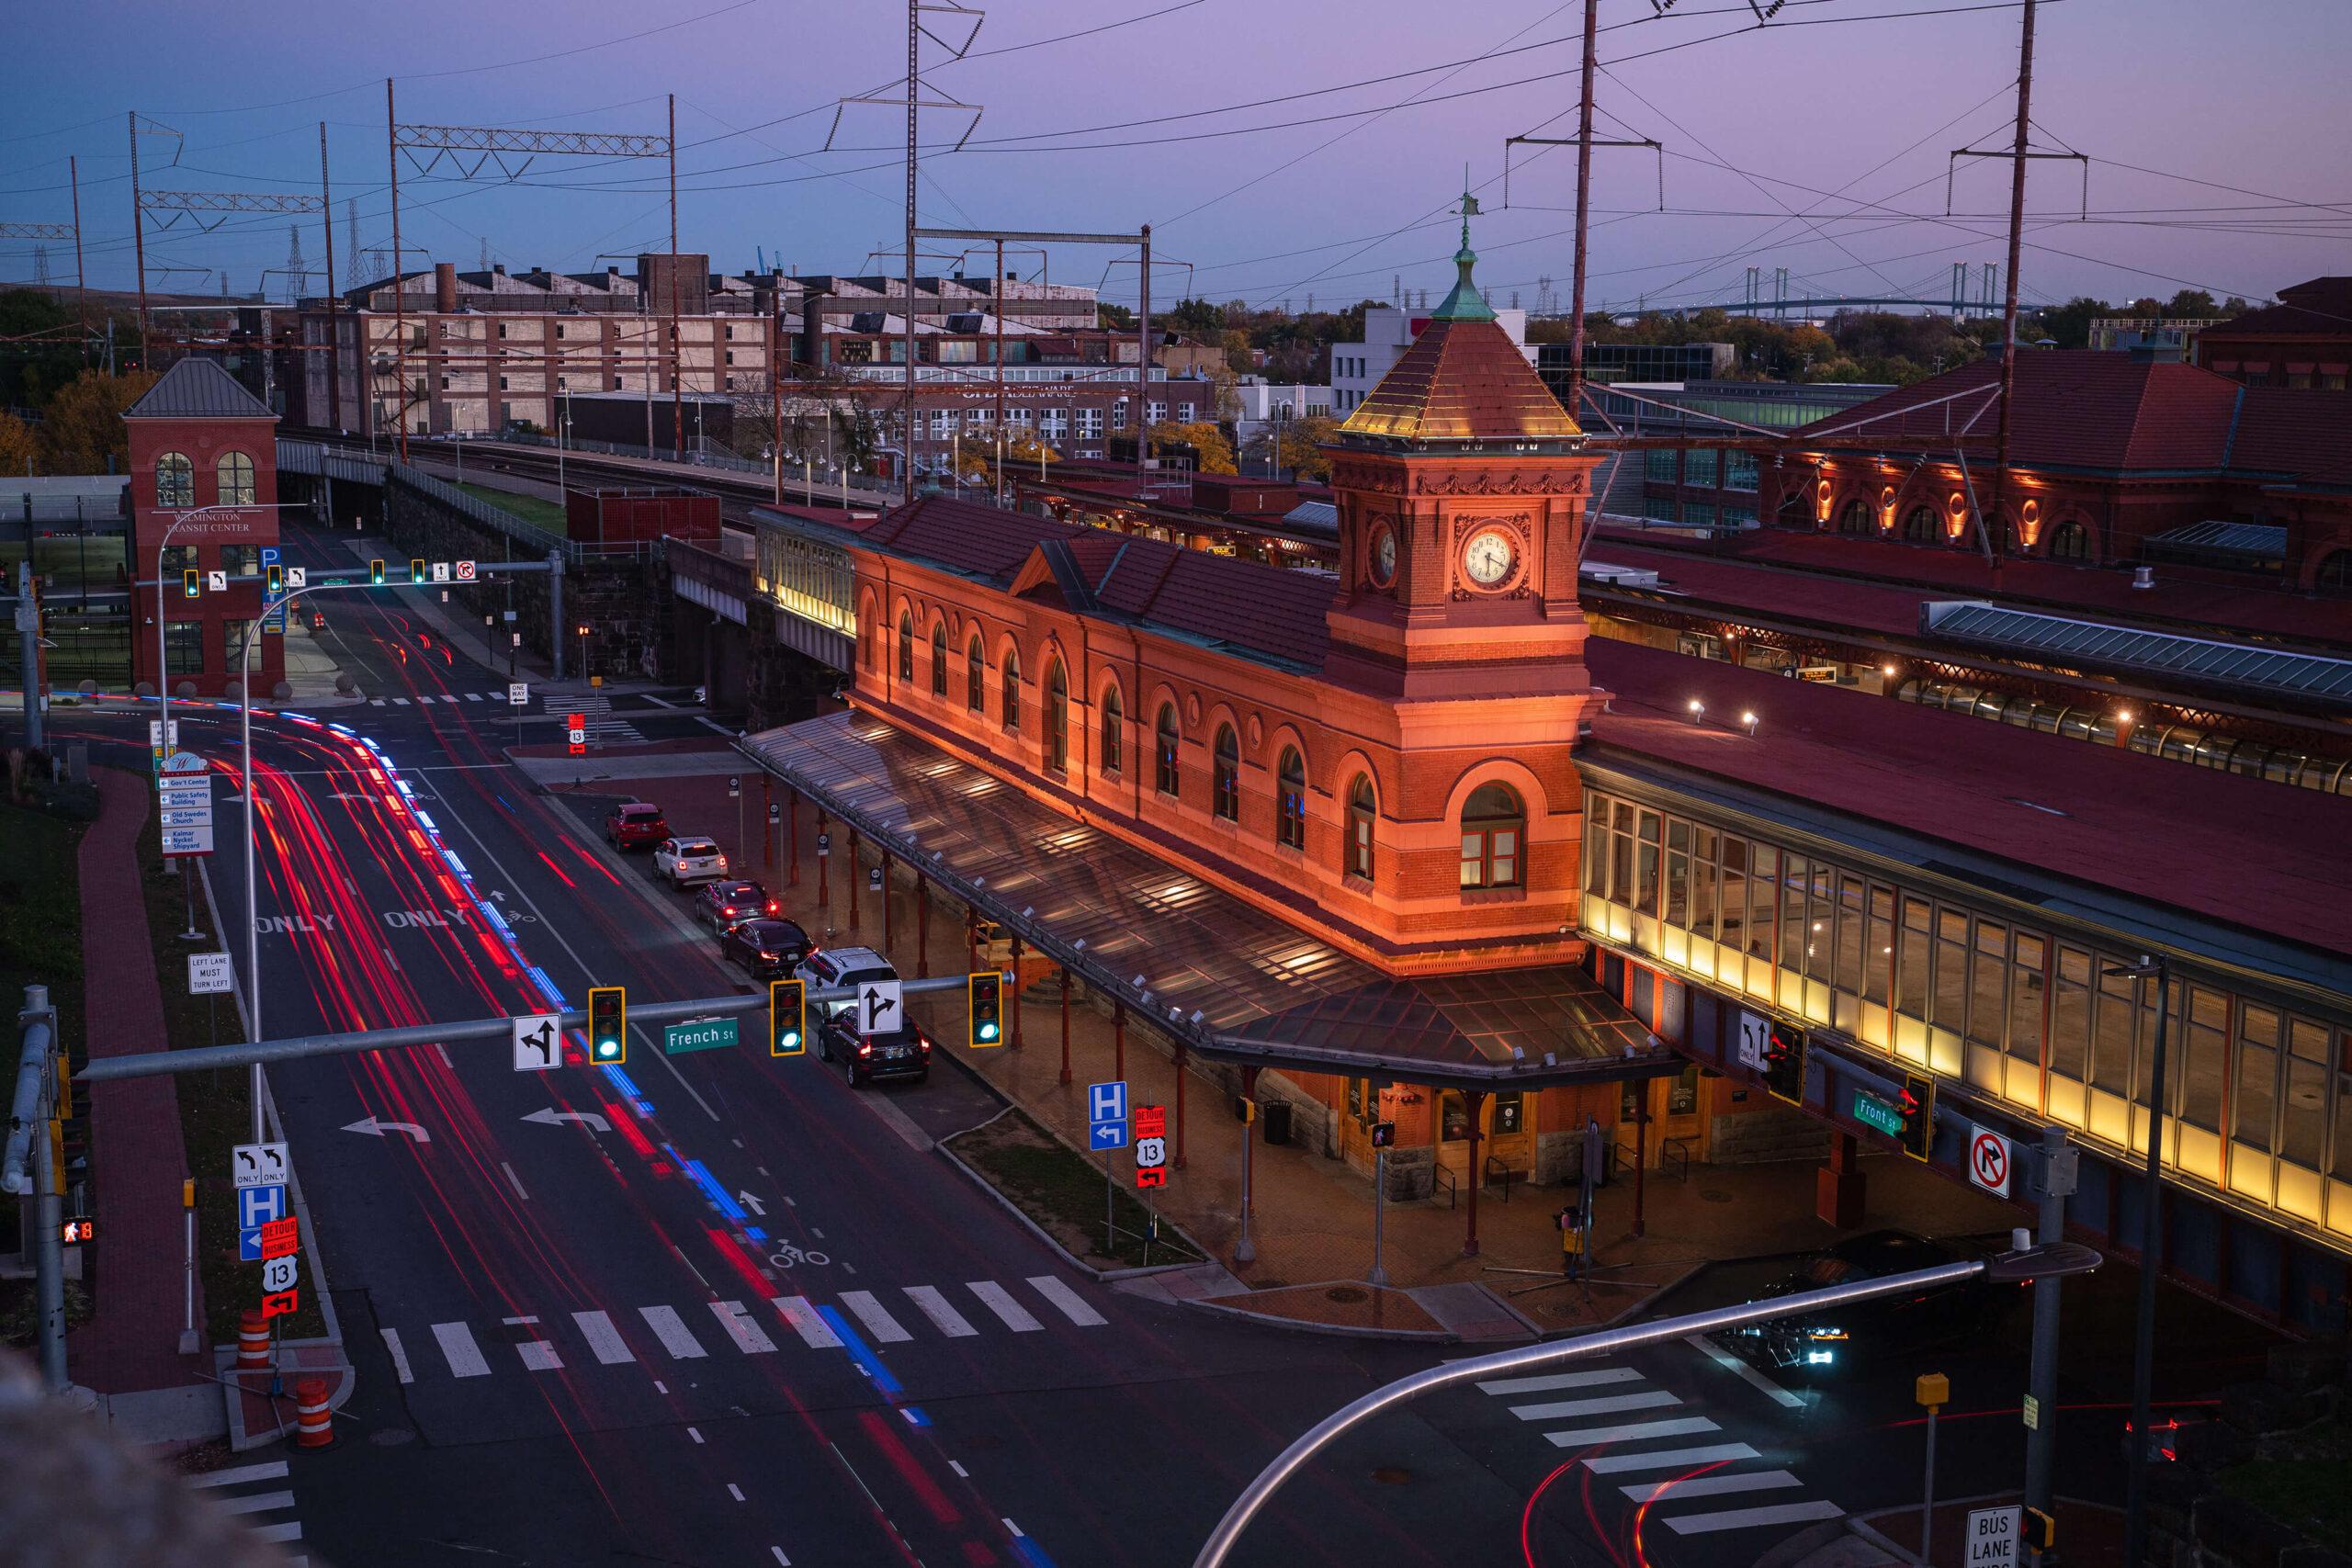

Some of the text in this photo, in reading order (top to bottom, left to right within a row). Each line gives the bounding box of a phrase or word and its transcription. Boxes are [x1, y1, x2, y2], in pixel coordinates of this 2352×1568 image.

[962, 384, 1077, 398] OADELAWARE
[165, 524, 250, 533] TRANSIT CENTER
[262, 549, 277, 568] P
[572, 732, 582, 741] 13
[255, 913, 334, 933] ONLY
[383, 908, 468, 928] ONLY
[199, 968, 220, 977] MUST
[212, 979, 228, 987] LEFT
[669, 1028, 734, 1047] French St
[1740, 1049, 1754, 1061] ONLY
[1094, 1085, 1122, 1120] H
[1136, 1110, 1163, 1121] DETOUR
[1860, 1099, 1886, 1124] Front
[1137, 1126, 1163, 1134] BUSINESS
[1143, 1144, 1159, 1161] 13
[237, 1173, 285, 1183] ONLY ONLY
[245, 1188, 278, 1227] H
[263, 1221, 295, 1238] DETOUR
[264, 1240, 295, 1256] BUSINESS
[271, 1264, 289, 1285] 13
[1979, 1516, 2008, 1536] BUS
[1973, 1539, 2011, 1560] LANE
